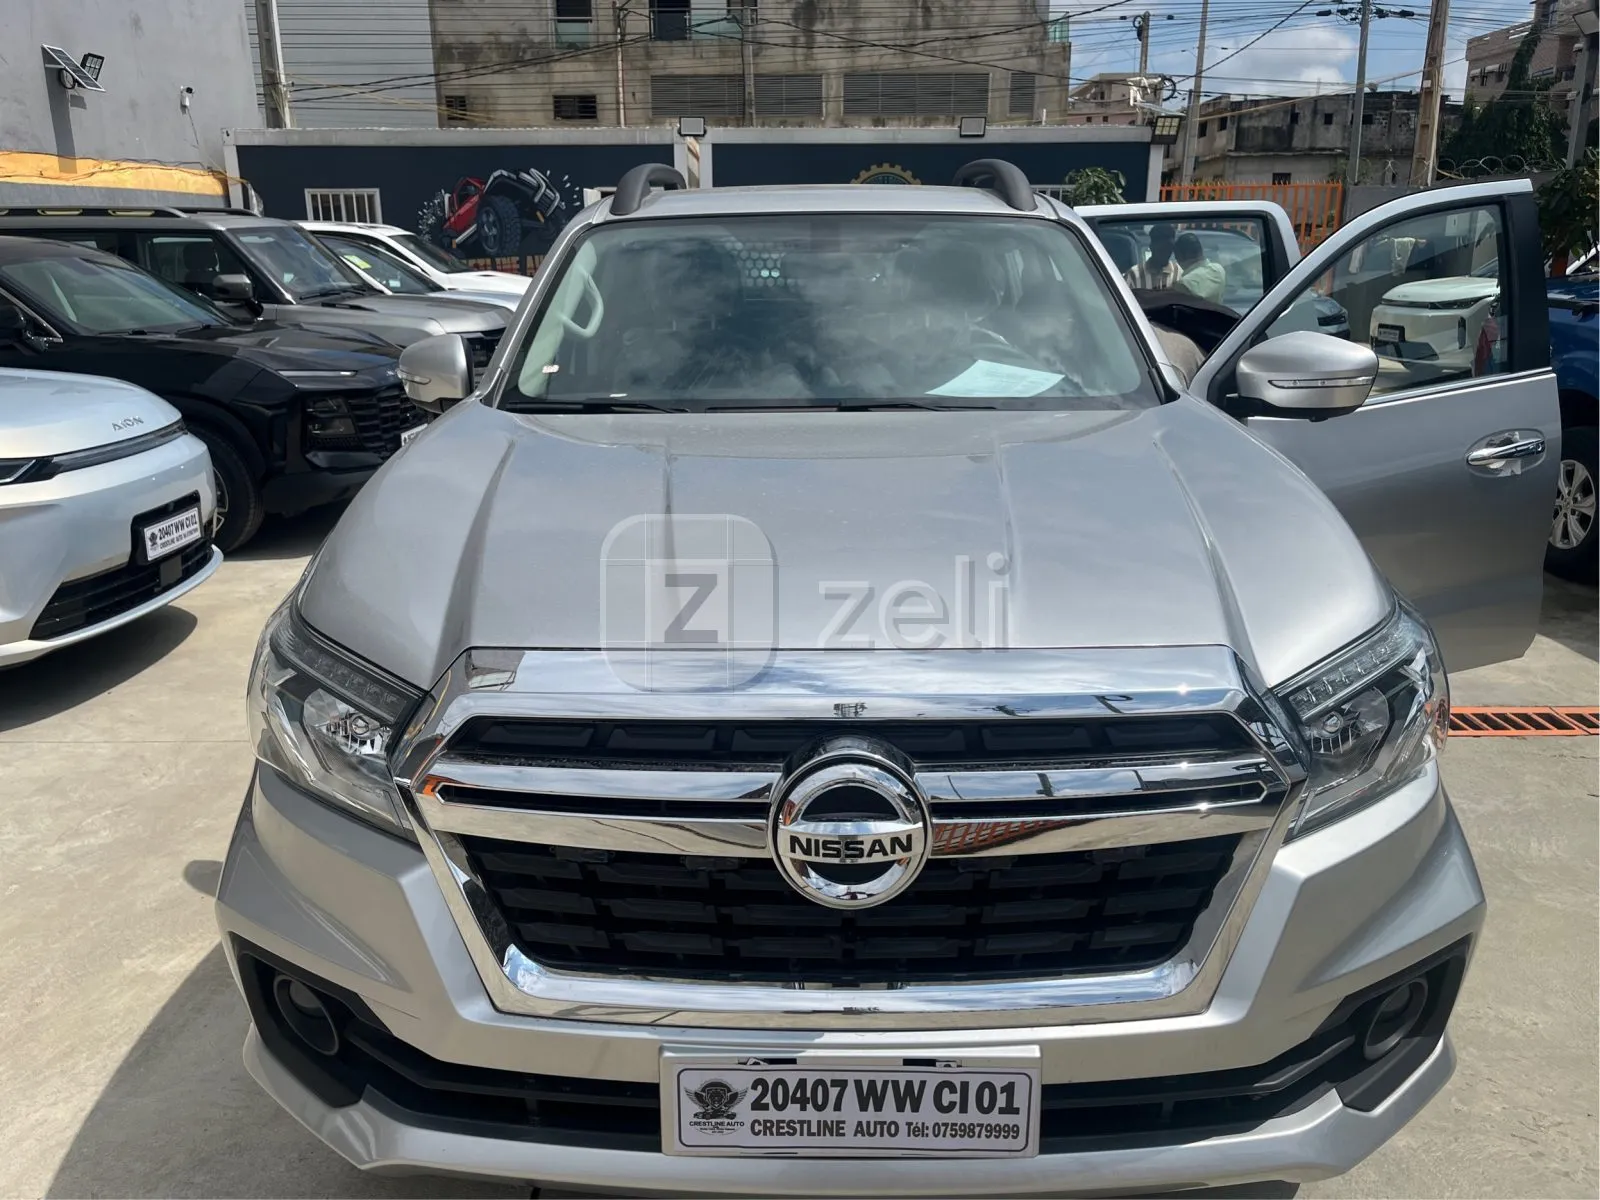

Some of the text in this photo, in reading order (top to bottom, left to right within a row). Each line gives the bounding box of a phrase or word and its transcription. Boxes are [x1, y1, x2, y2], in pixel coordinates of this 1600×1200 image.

[111, 417, 144, 431] AION
[789, 833, 913, 859] NISSAN
[750, 1077, 1020, 1115] 20407 WW CI 01
[751, 1119, 1020, 1140] CRESTLINE AUTO Tél: 0759879999
